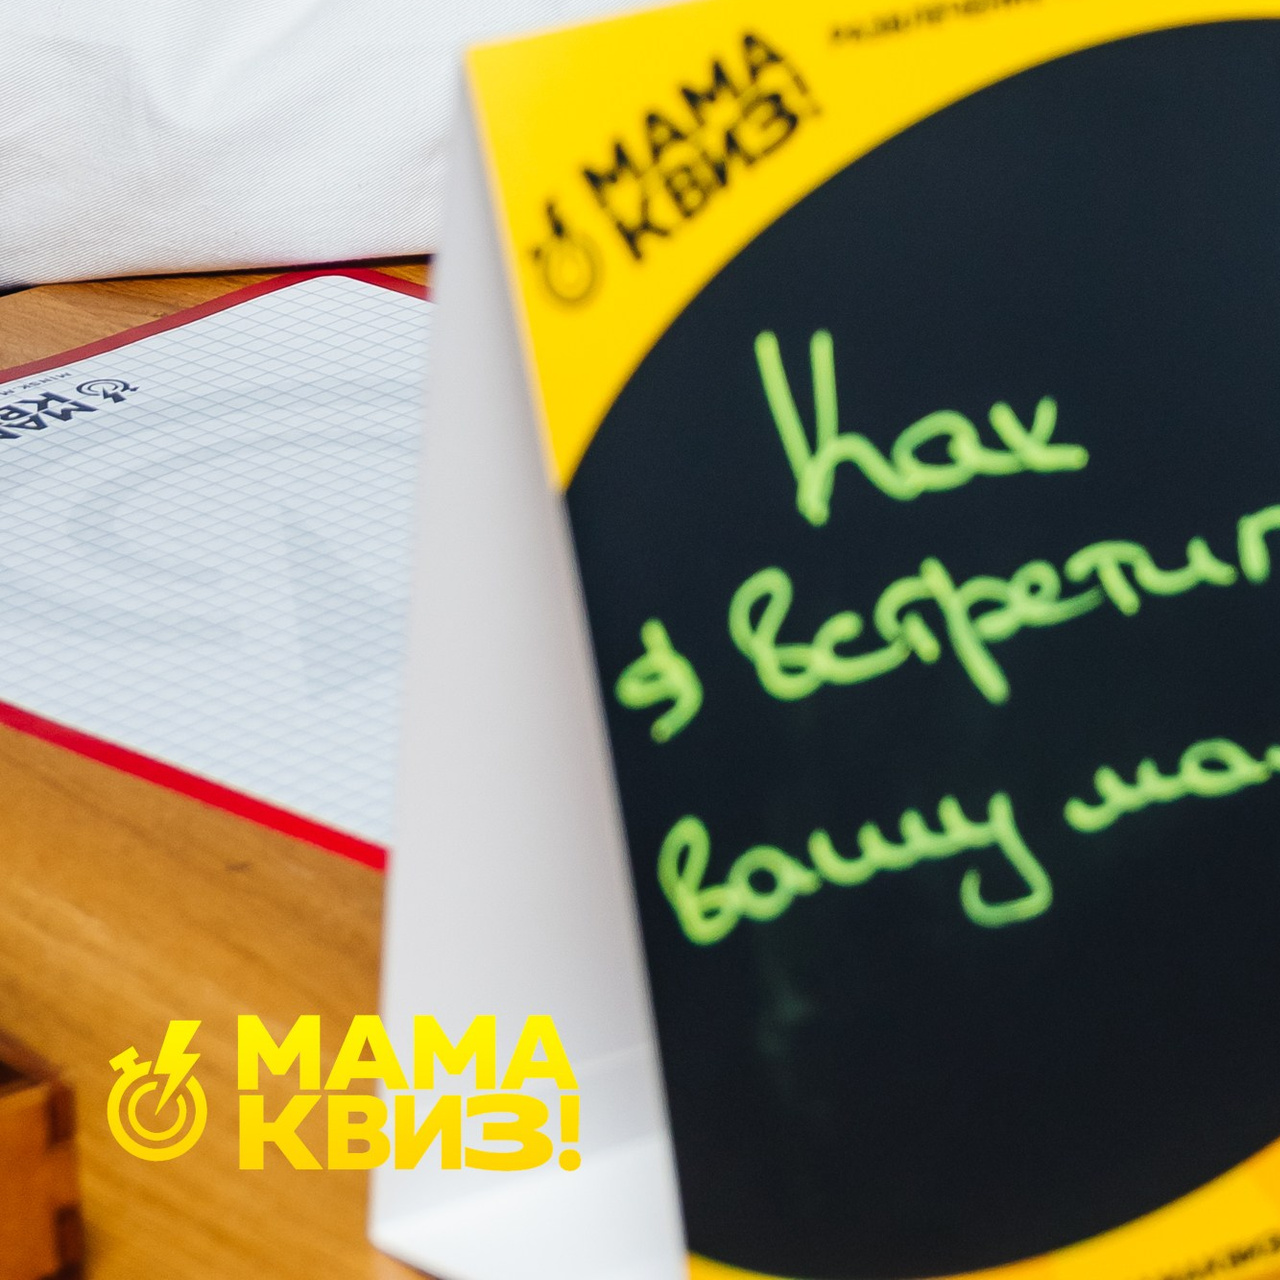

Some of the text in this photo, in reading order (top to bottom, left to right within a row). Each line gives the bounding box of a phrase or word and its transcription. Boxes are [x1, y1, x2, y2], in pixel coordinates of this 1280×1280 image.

[582, 28, 784, 199] МАМА
[605, 68, 821, 262] КВИЗ!
[755, 328, 1089, 527] Как
[615, 618, 703, 742] я
[657, 792, 1053, 946] вашу
